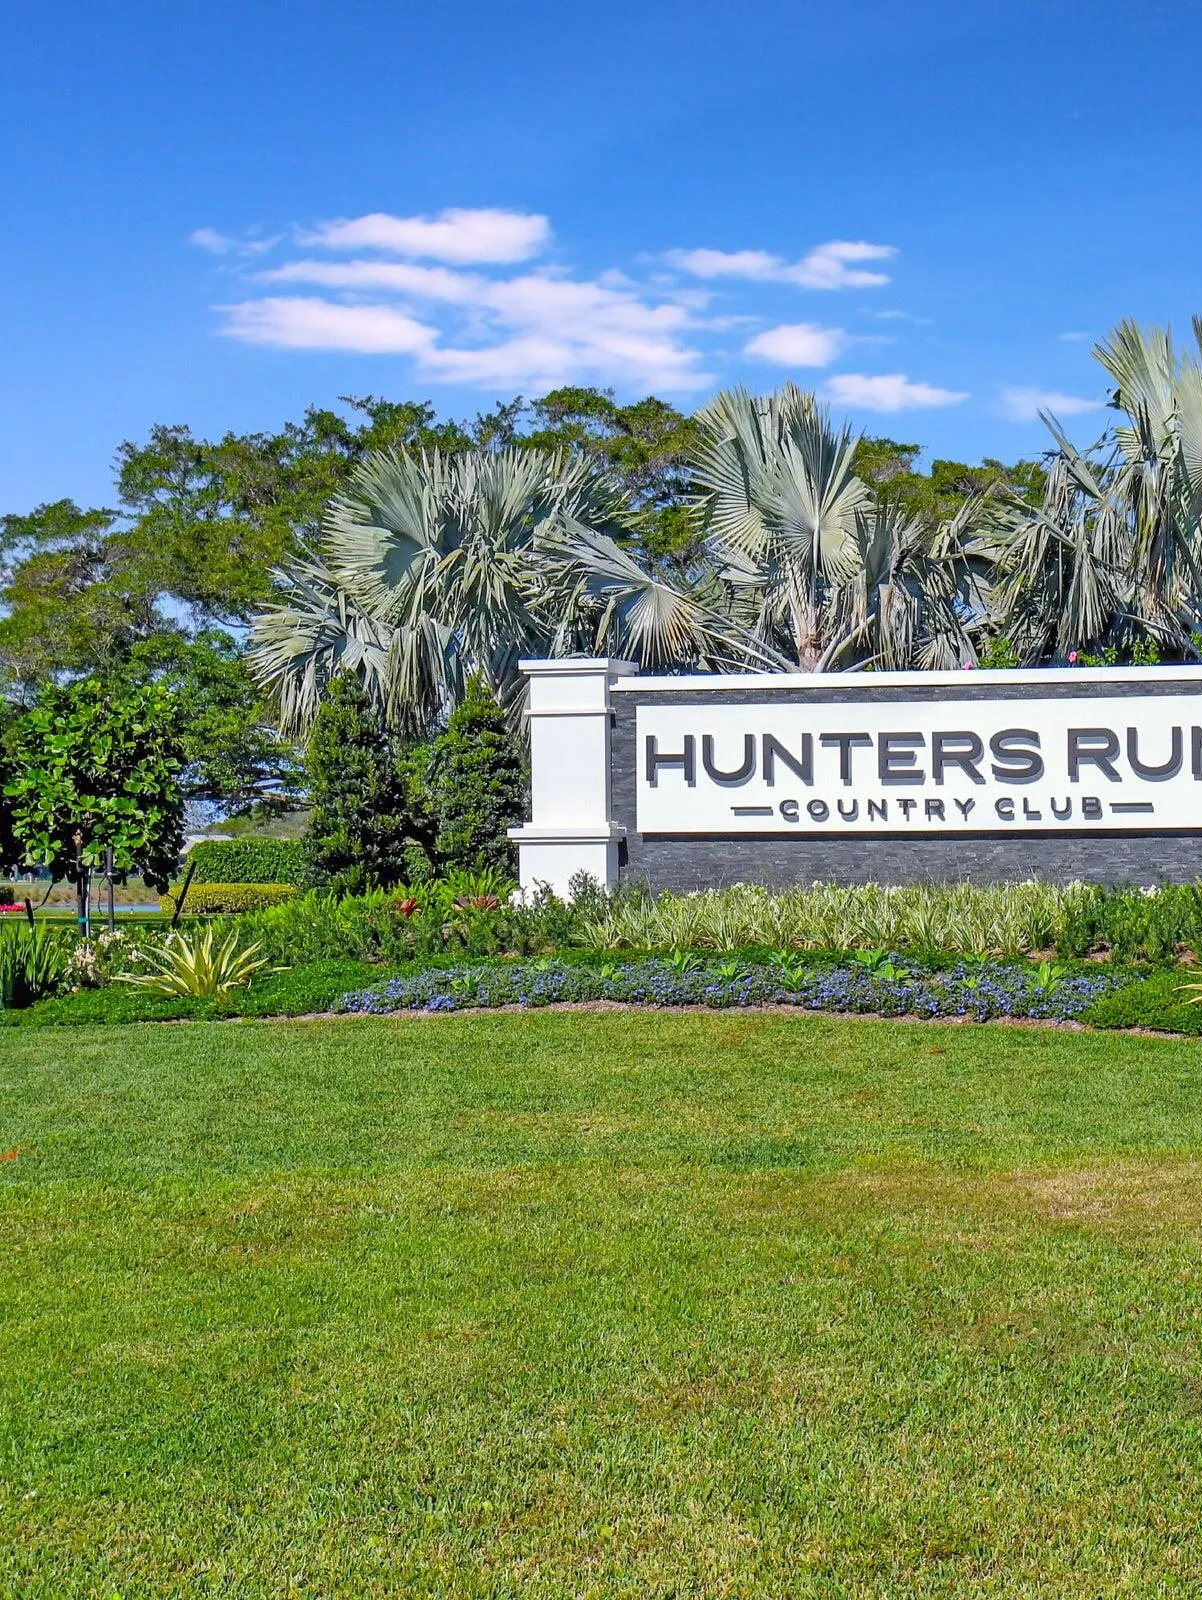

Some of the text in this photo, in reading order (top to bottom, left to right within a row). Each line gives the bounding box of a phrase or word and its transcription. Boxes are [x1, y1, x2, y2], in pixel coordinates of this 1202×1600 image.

[645, 729, 1043, 786] HUNTERS
[779, 797, 1103, 822] COUNTRY CLUB
